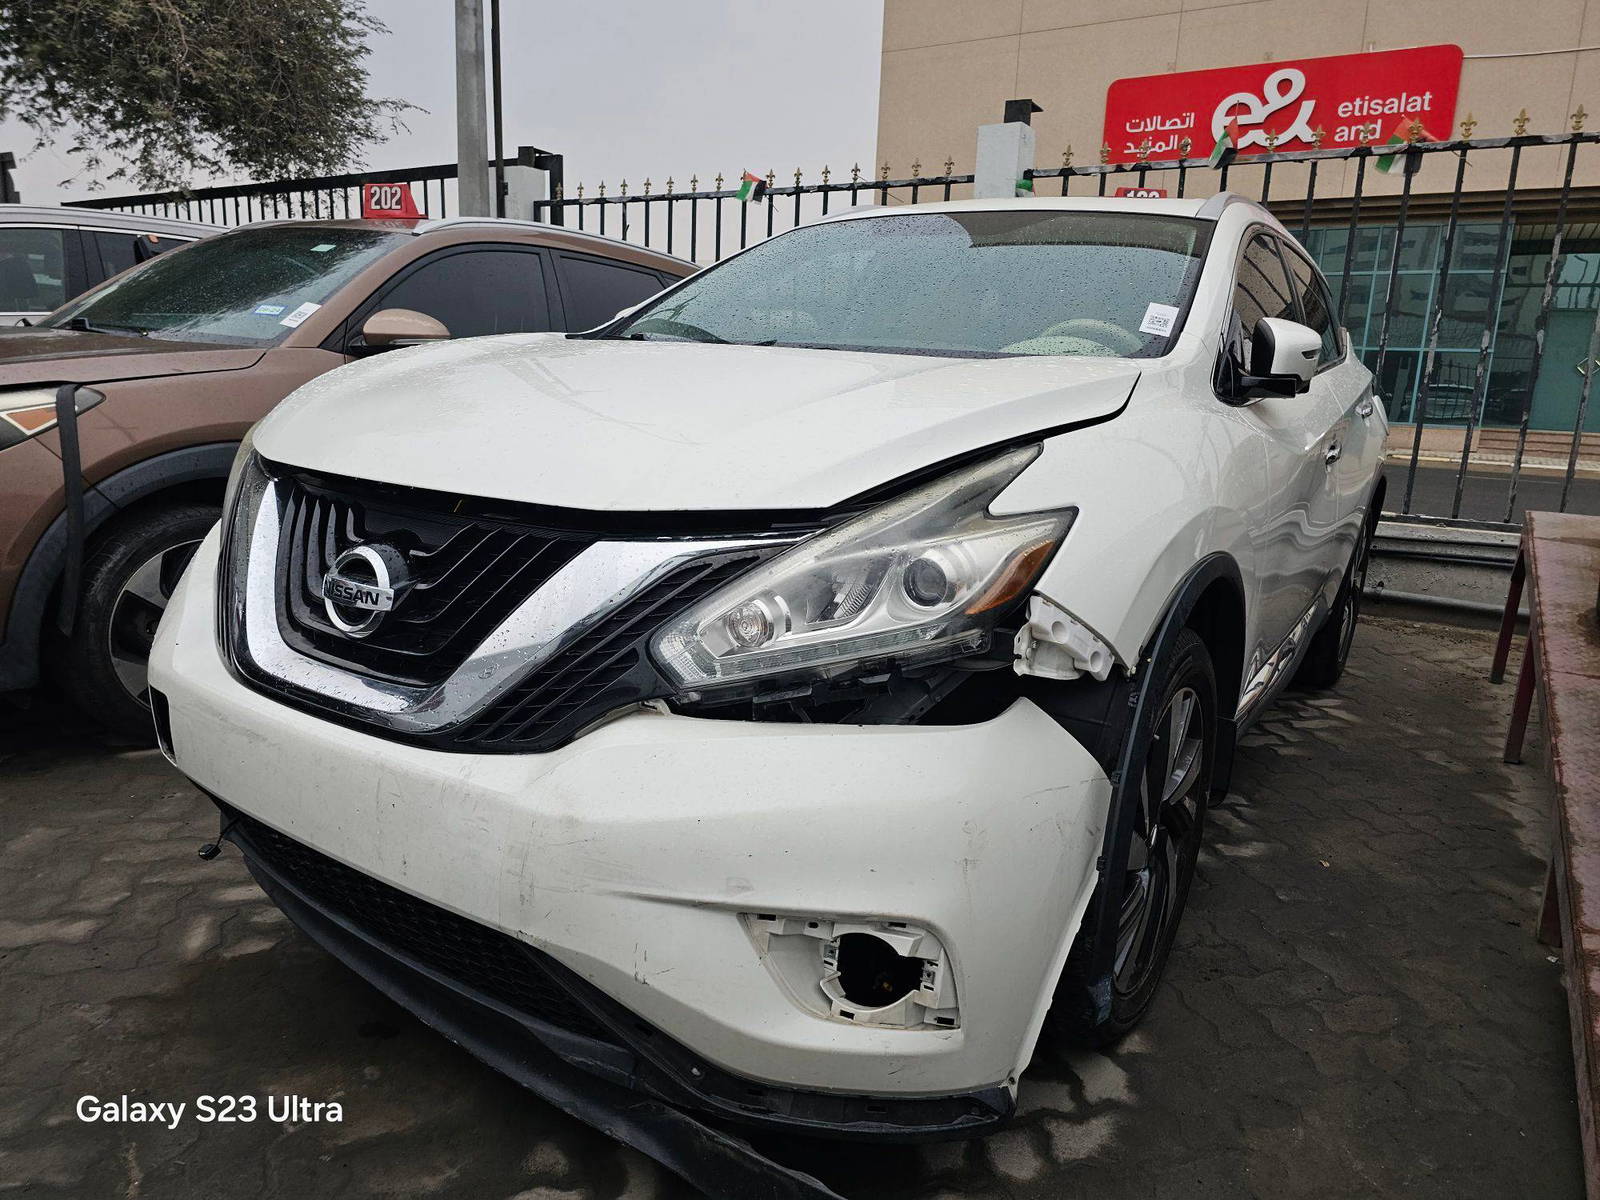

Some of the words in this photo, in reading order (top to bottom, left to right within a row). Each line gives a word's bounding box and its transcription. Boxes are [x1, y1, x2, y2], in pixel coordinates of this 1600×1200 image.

[1337, 91, 1432, 118] etisalat
[1125, 112, 1195, 133] اتصالات
[1334, 119, 1382, 142] and
[370, 186, 401, 210] 202
[324, 578, 380, 606] NISSAN
